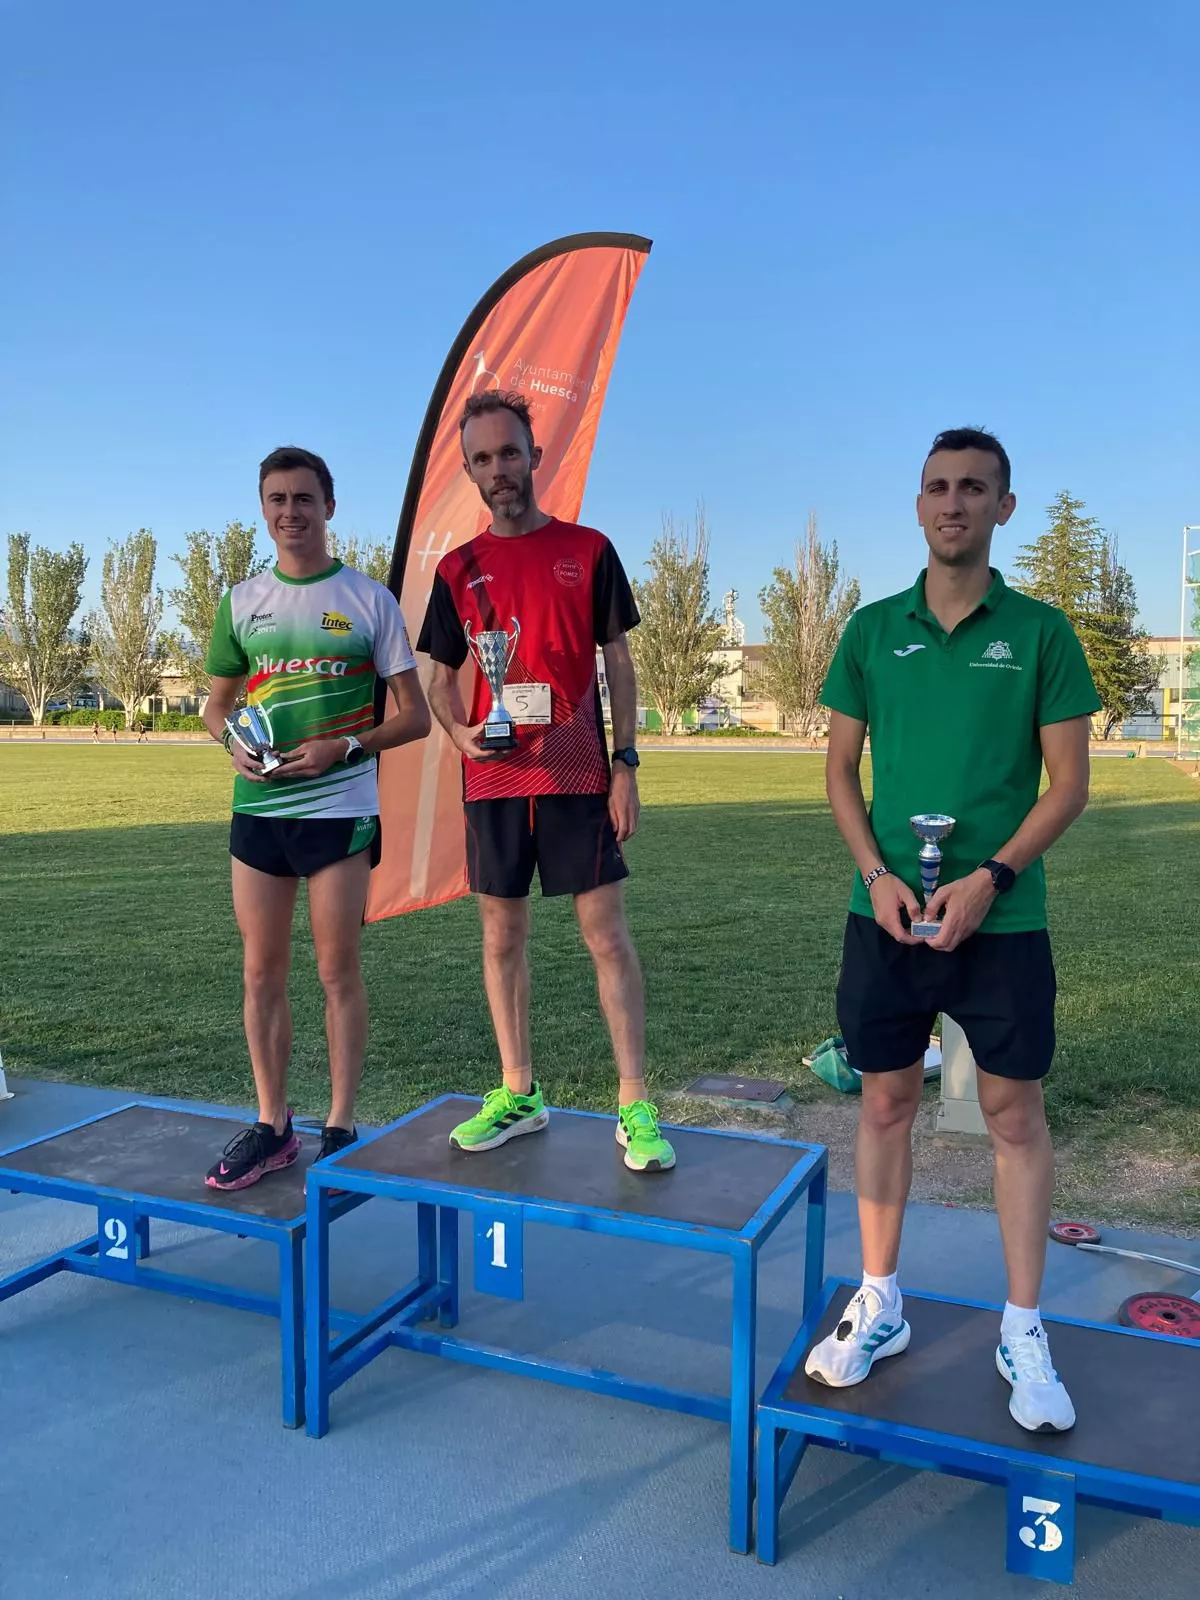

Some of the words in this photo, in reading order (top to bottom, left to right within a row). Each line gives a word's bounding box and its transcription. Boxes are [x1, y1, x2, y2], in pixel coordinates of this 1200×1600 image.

[510, 376, 526, 389] de
[529, 378, 578, 402] Huesca
[255, 654, 348, 676] Huesca
[104, 1218, 129, 1260] 2
[486, 1221, 508, 1268] 1
[1019, 1495, 1063, 1551] 3
